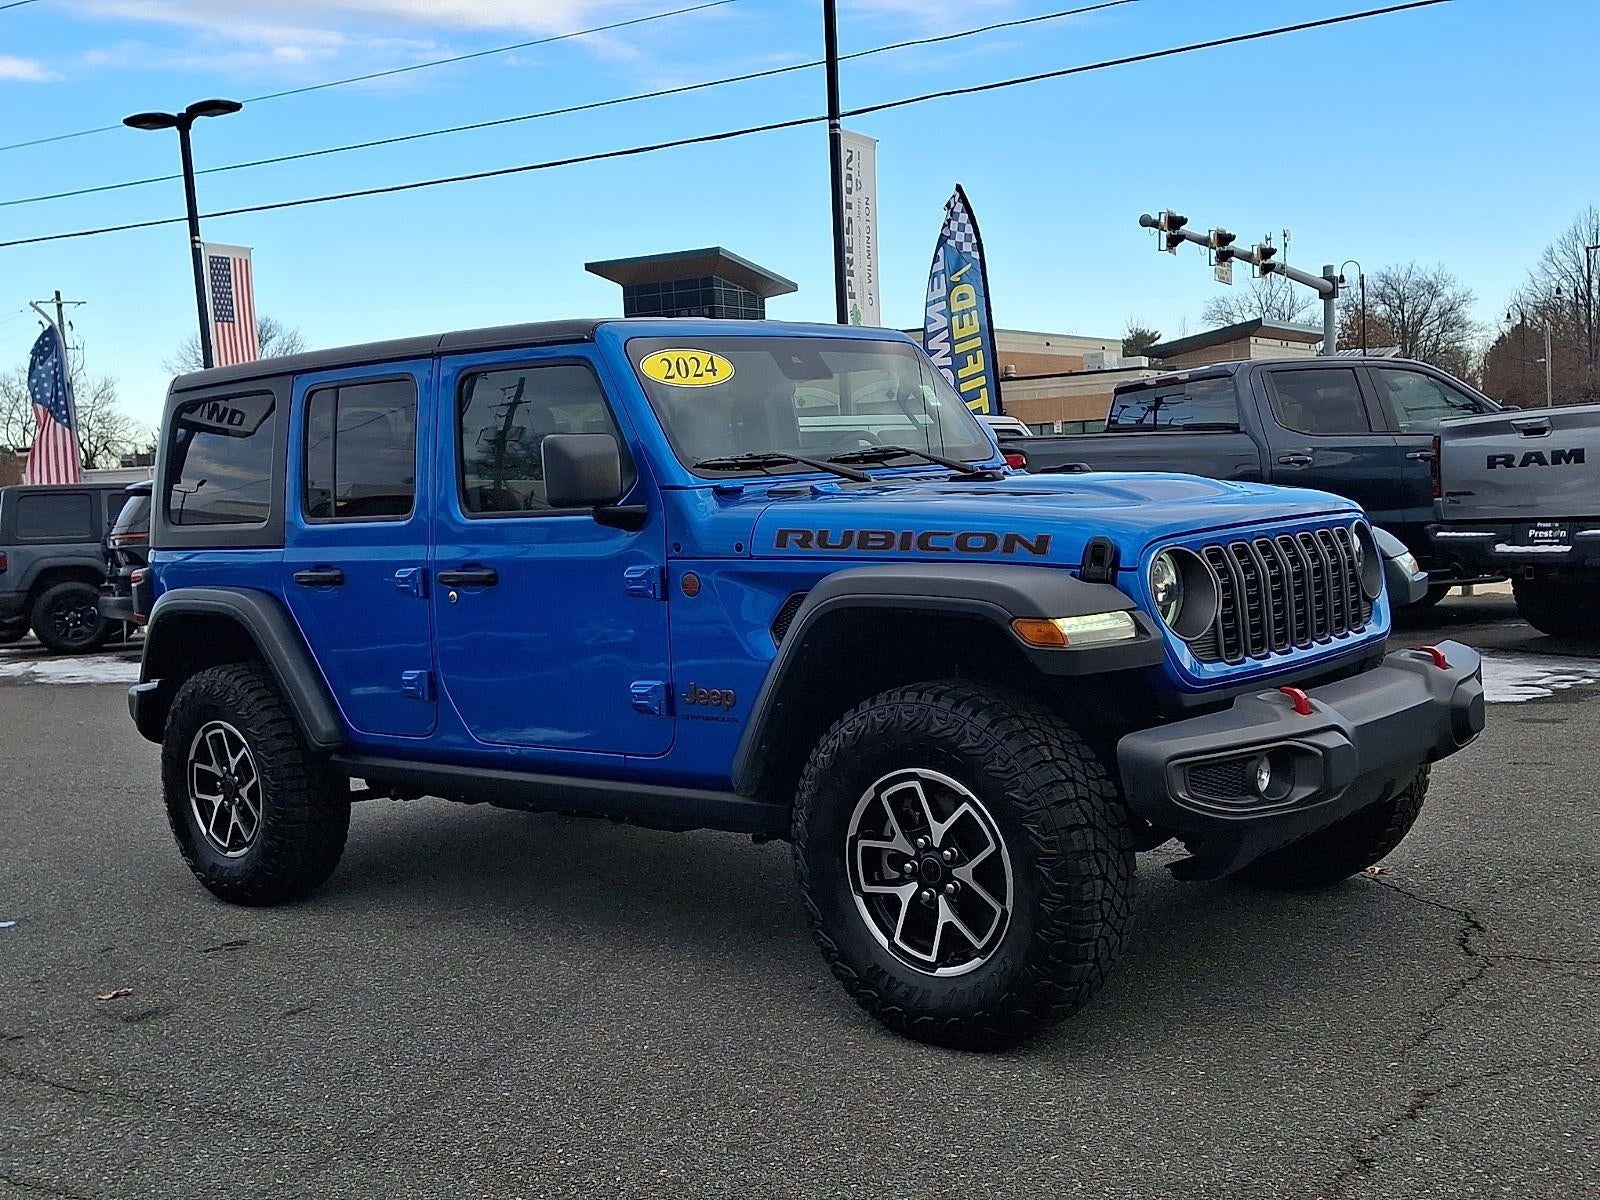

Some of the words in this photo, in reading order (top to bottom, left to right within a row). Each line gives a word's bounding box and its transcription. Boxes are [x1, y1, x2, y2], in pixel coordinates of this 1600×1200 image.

[845, 148, 857, 300] PRESTON
[865, 196, 873, 285] WILMINGTON
[867, 288, 874, 306] OF
[660, 355, 718, 380] 2024
[1487, 448, 1586, 470] RAM
[773, 528, 1052, 556] RUBICON
[1528, 529, 1567, 537] Preston
[681, 681, 737, 710] Jeep
